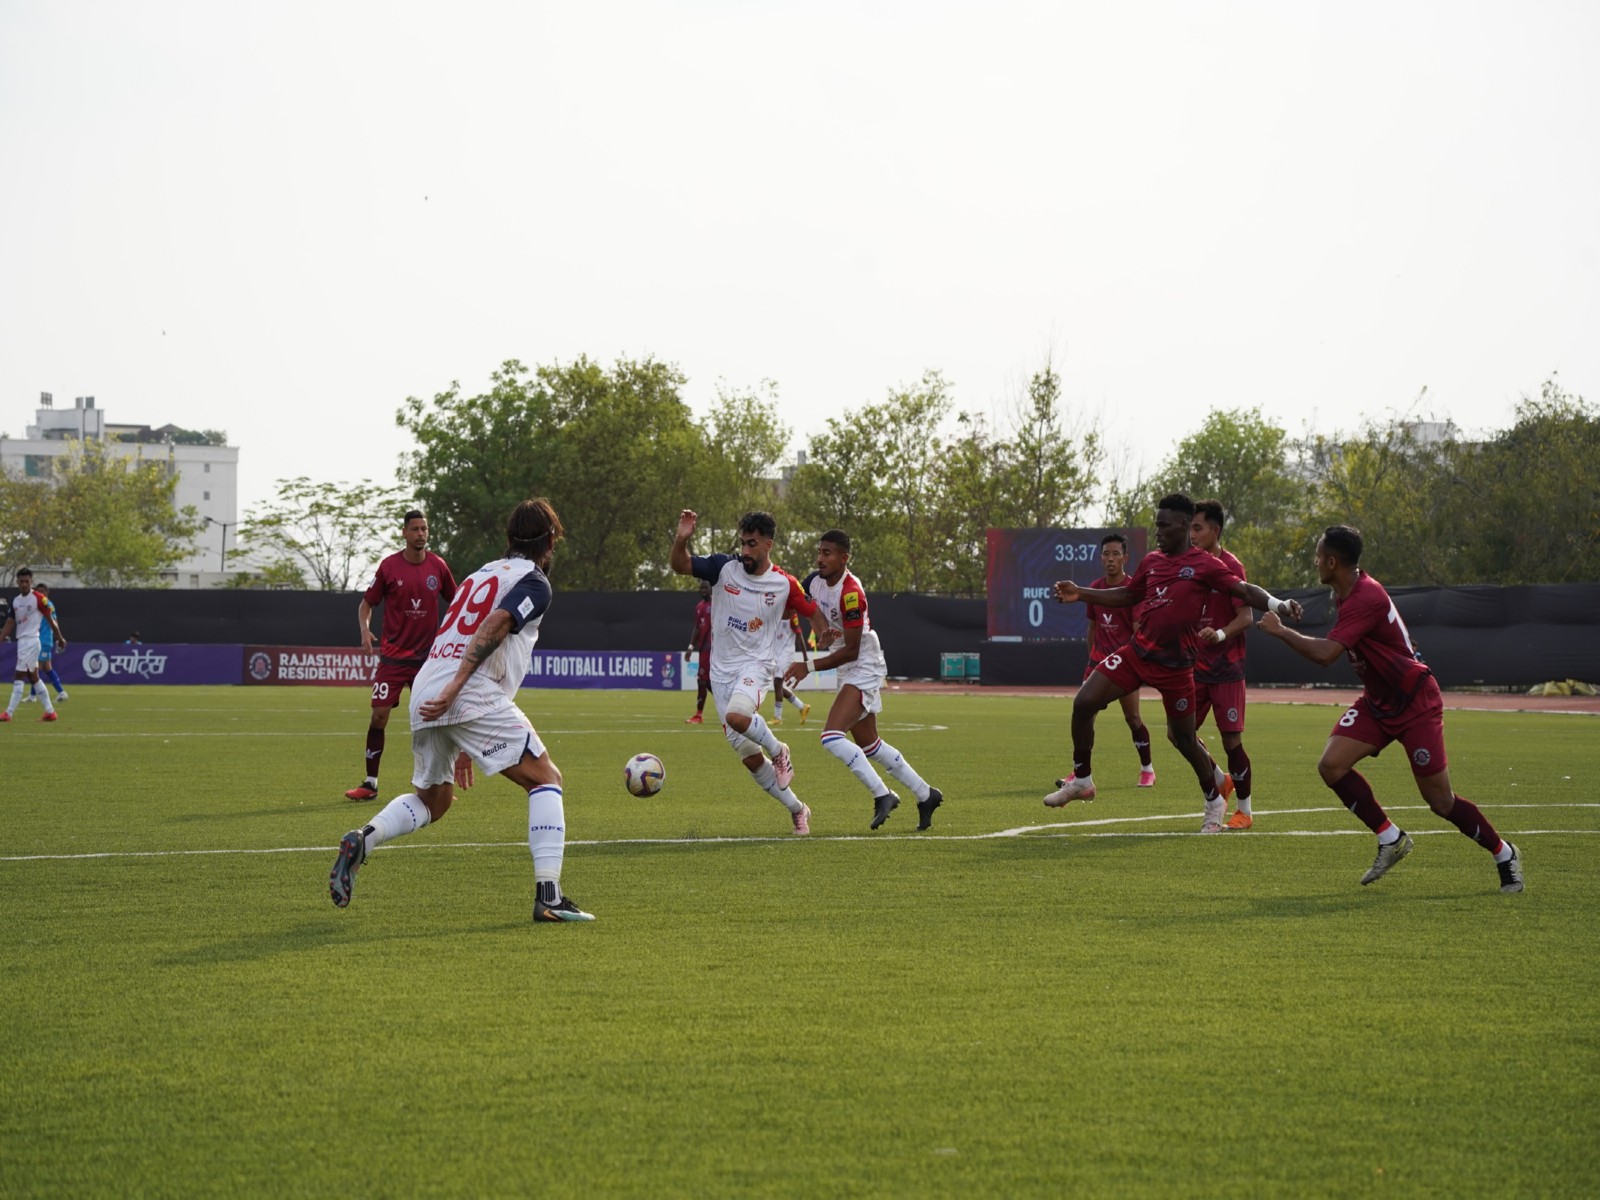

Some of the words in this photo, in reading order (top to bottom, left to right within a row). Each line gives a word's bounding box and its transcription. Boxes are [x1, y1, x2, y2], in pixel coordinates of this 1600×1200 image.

[1055, 544, 1097, 561] 33:37
[1023, 587, 1050, 599] RUFC
[435, 575, 499, 637] 99
[1028, 599, 1044, 627] 0
[727, 621, 748, 632] TYRES
[728, 616, 748, 627] BIRLA
[279, 653, 362, 668] RAJASTHAN
[546, 656, 605, 677] FOOTBALL
[609, 658, 653, 678] LEAGUE
[1103, 654, 1122, 670] 3
[278, 666, 367, 681] RESIDENTIAL
[371, 682, 389, 700] 29
[1339, 708, 1359, 727] 8
[482, 742, 507, 758] Nautica
